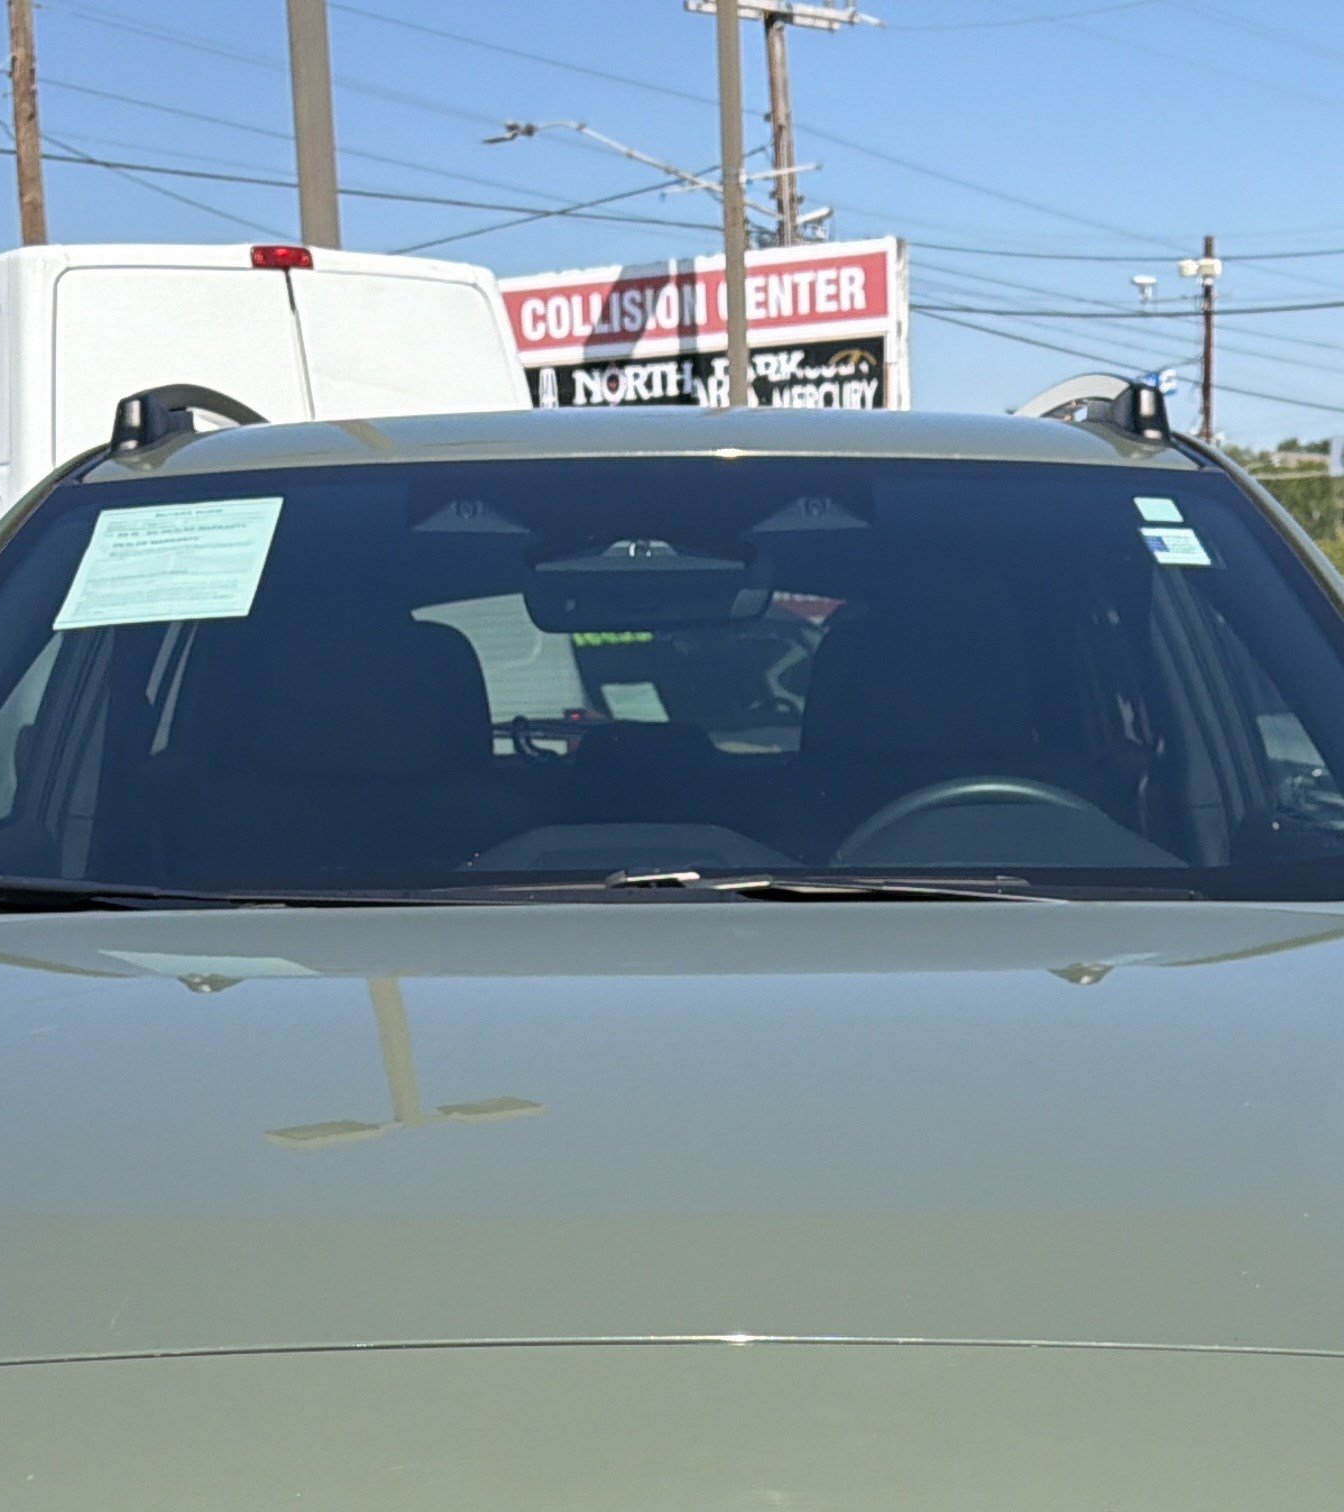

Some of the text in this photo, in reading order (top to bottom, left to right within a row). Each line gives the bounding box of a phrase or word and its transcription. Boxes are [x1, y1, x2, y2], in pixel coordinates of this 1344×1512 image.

[520, 283, 707, 342] COLLISION
[571, 361, 693, 405] NORTH
[772, 378, 879, 409] MERCURY
